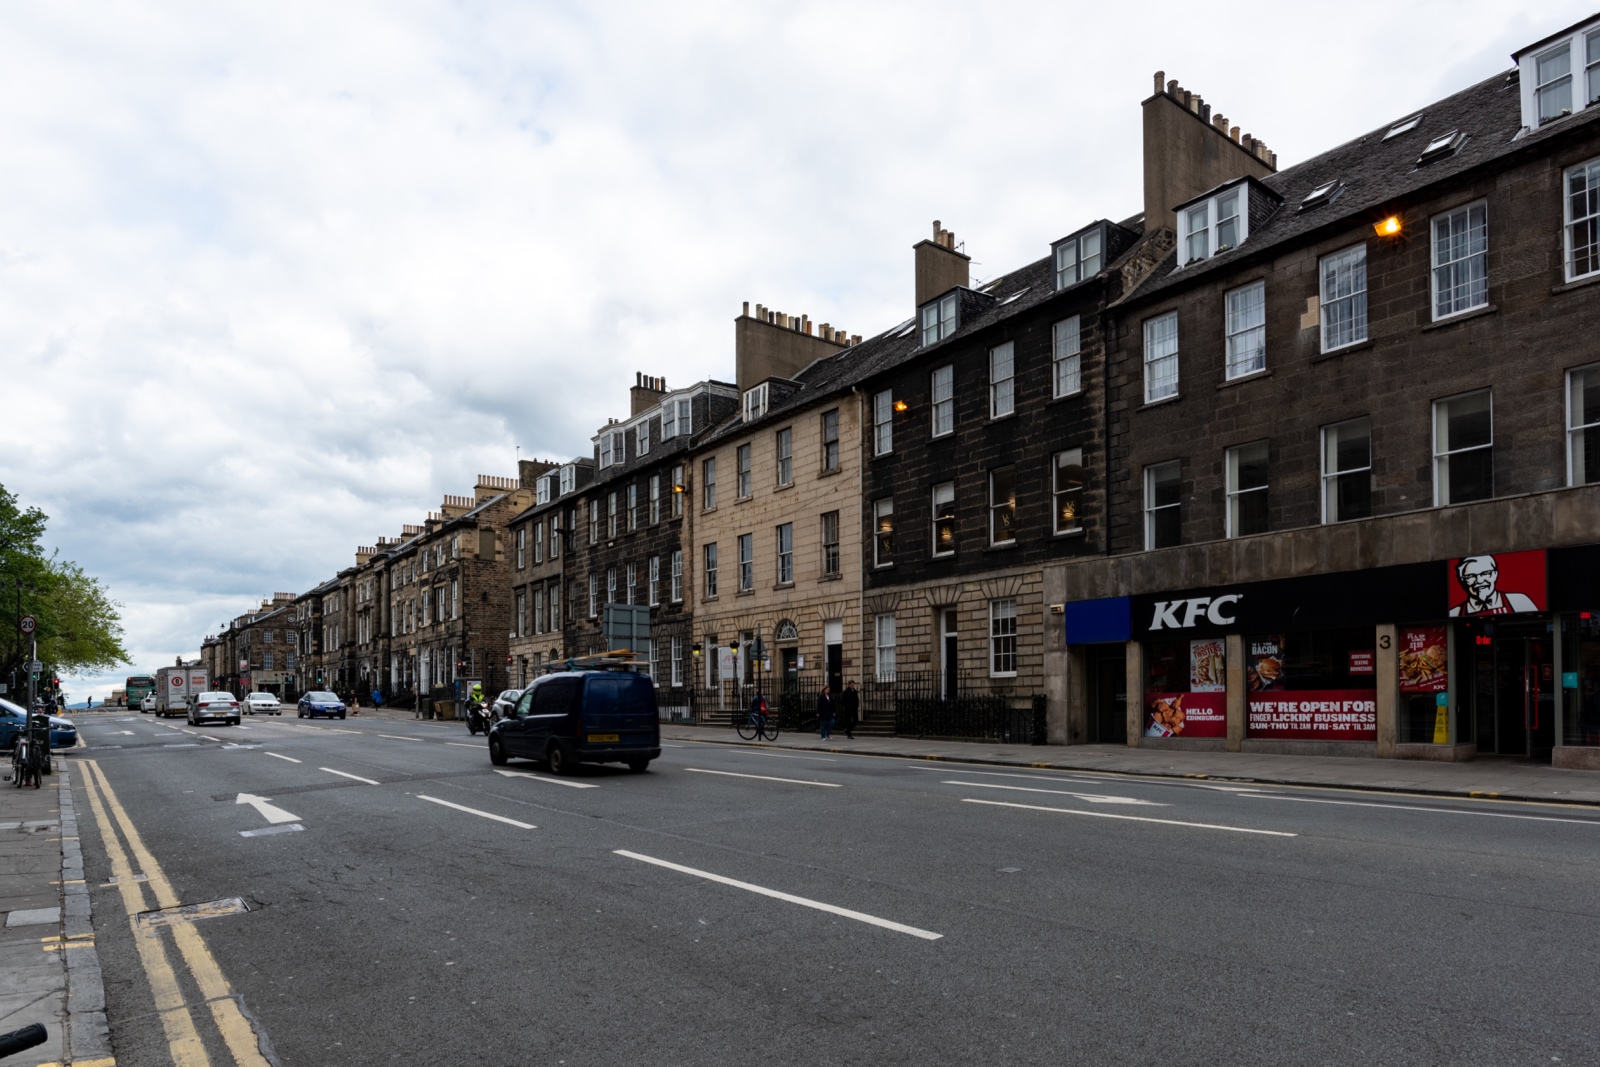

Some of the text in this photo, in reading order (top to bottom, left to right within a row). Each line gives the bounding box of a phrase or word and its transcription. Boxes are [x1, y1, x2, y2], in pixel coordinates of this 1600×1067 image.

[1149, 594, 1238, 630] KFC
[22, 620, 34, 629] 20
[1379, 635, 1391, 649] 3
[1476, 635, 1491, 645] Order
[1252, 646, 1278, 655] BACON
[1250, 701, 1375, 713] WE'RE OPEN FOR
[1250, 713, 1375, 722] FINGER LICKIN' BUSINESS
[1363, 723, 1375, 731] 3AM
